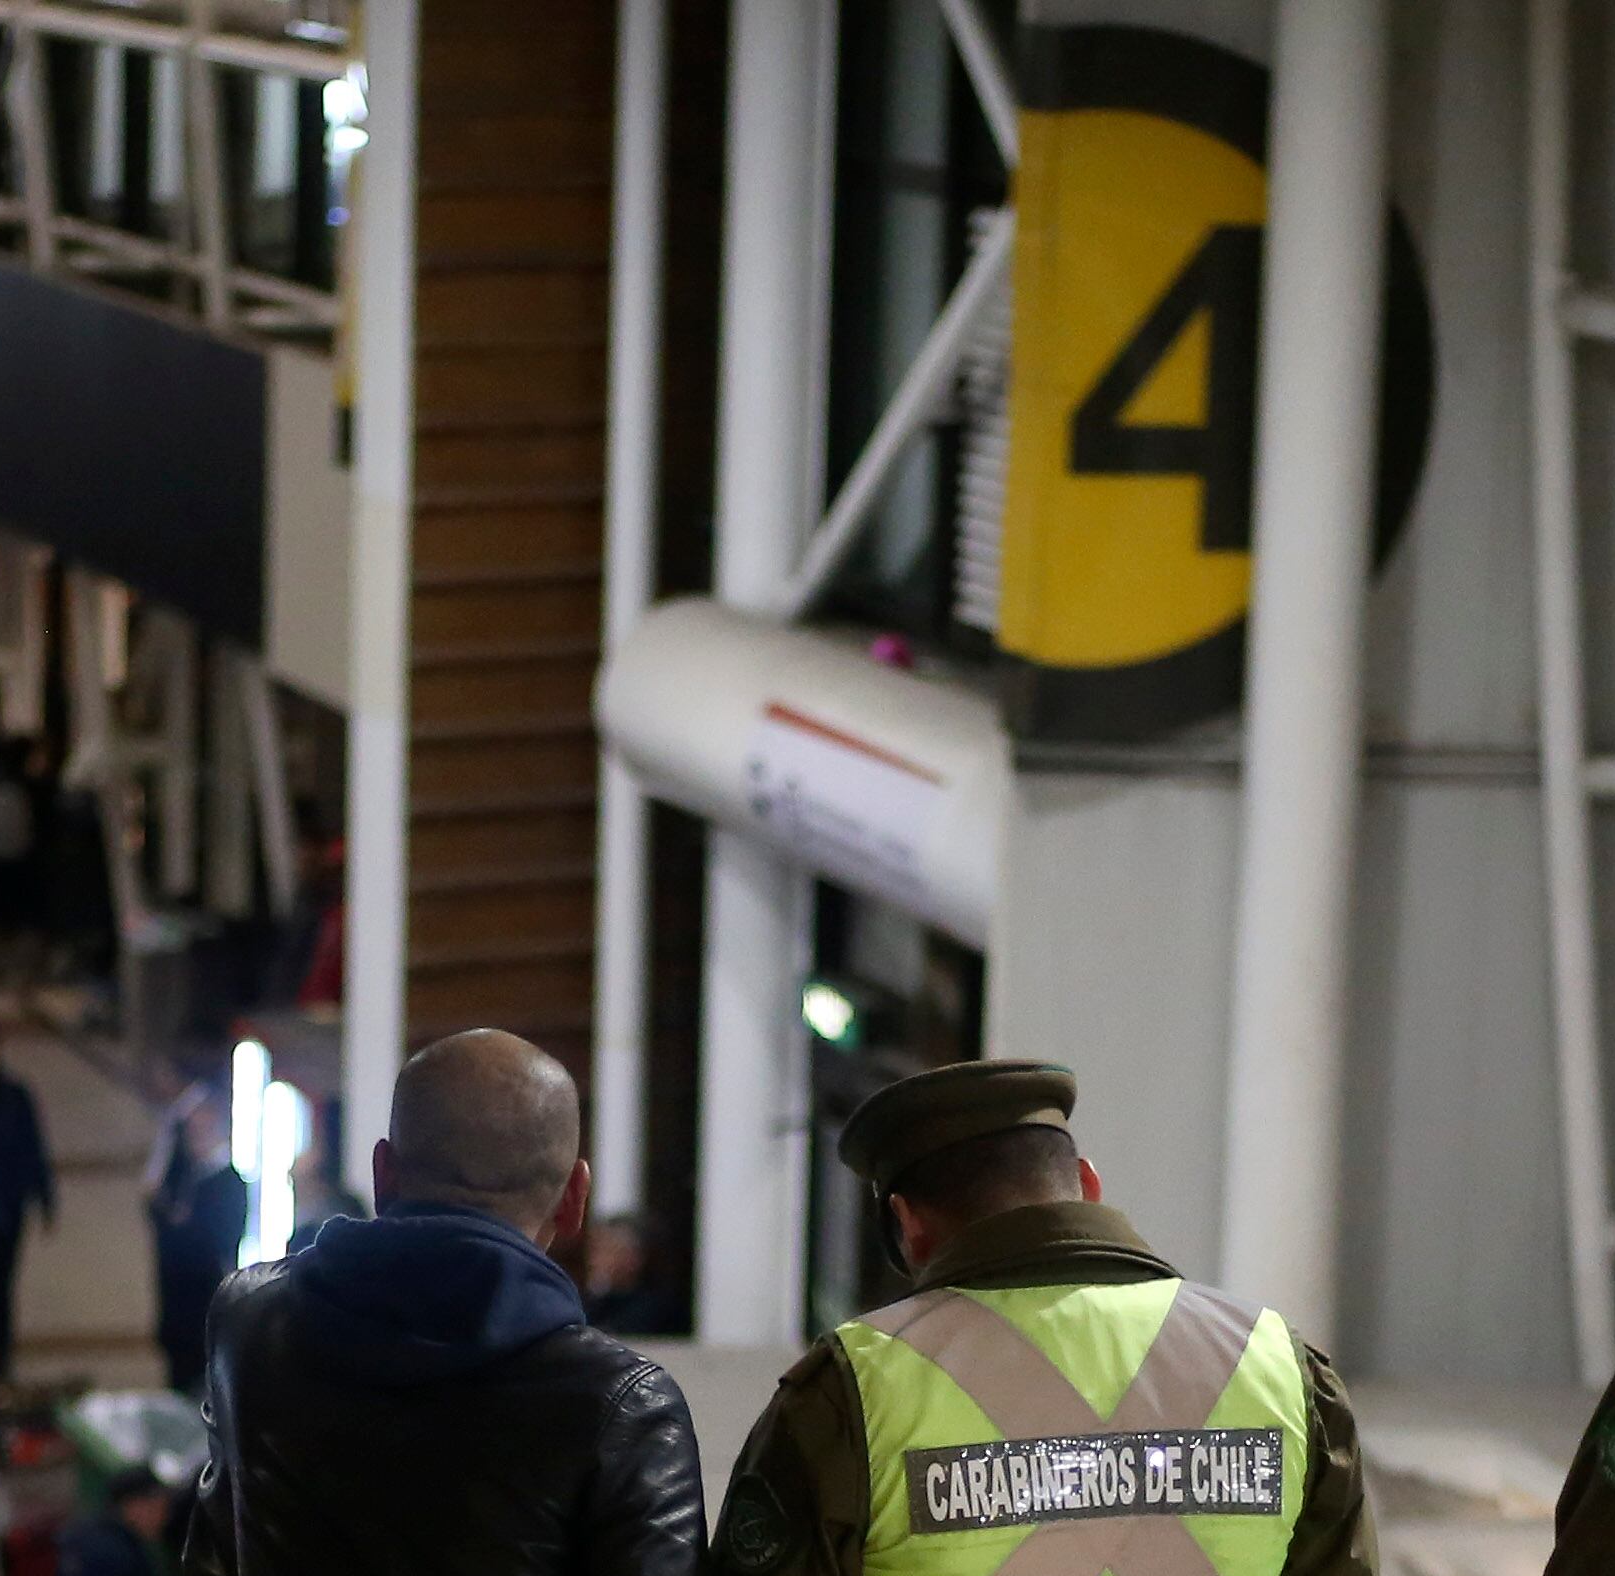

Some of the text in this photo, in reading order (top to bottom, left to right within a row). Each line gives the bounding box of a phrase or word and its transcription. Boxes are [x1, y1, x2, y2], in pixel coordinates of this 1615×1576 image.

[1070, 224, 1266, 552] 4
[926, 1446, 1271, 1521] CARABINEROS DE CHILE
